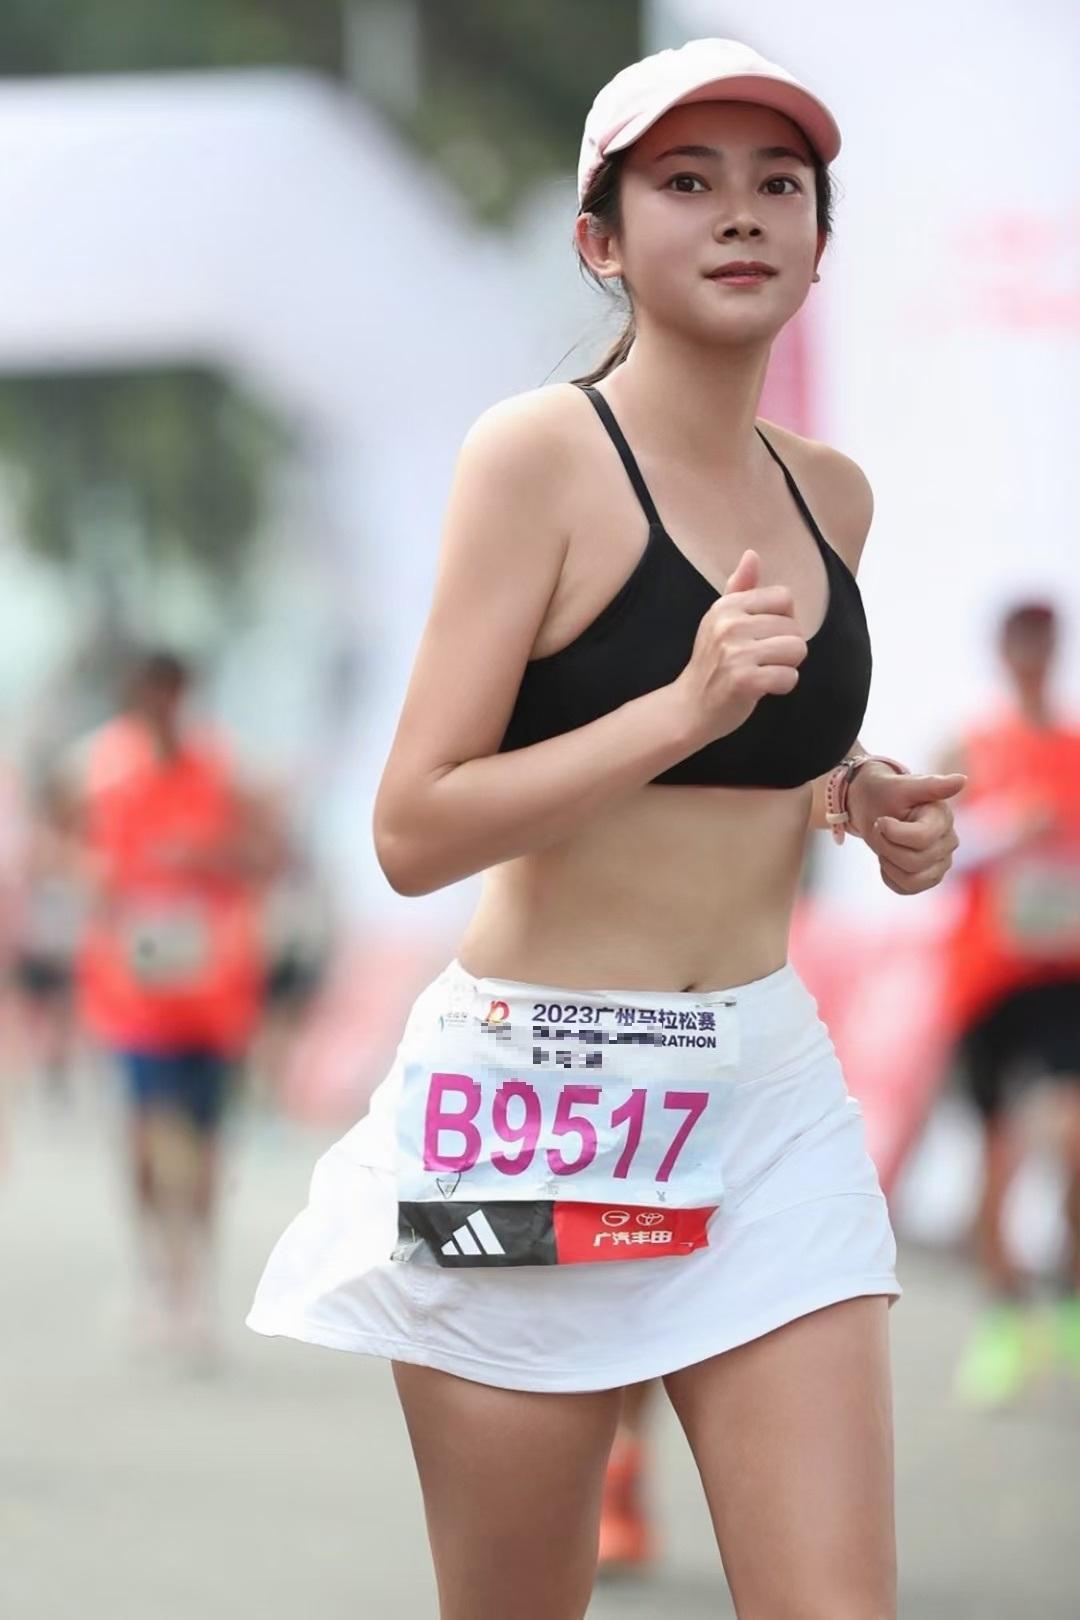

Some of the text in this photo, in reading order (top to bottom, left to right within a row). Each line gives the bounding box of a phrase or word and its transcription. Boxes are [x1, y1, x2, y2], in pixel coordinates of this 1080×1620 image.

[532, 1003, 717, 1032] 2023广州马拉松赛
[423, 1072, 711, 1183] B9517
[593, 1230, 673, 1247] 广汽丰田
